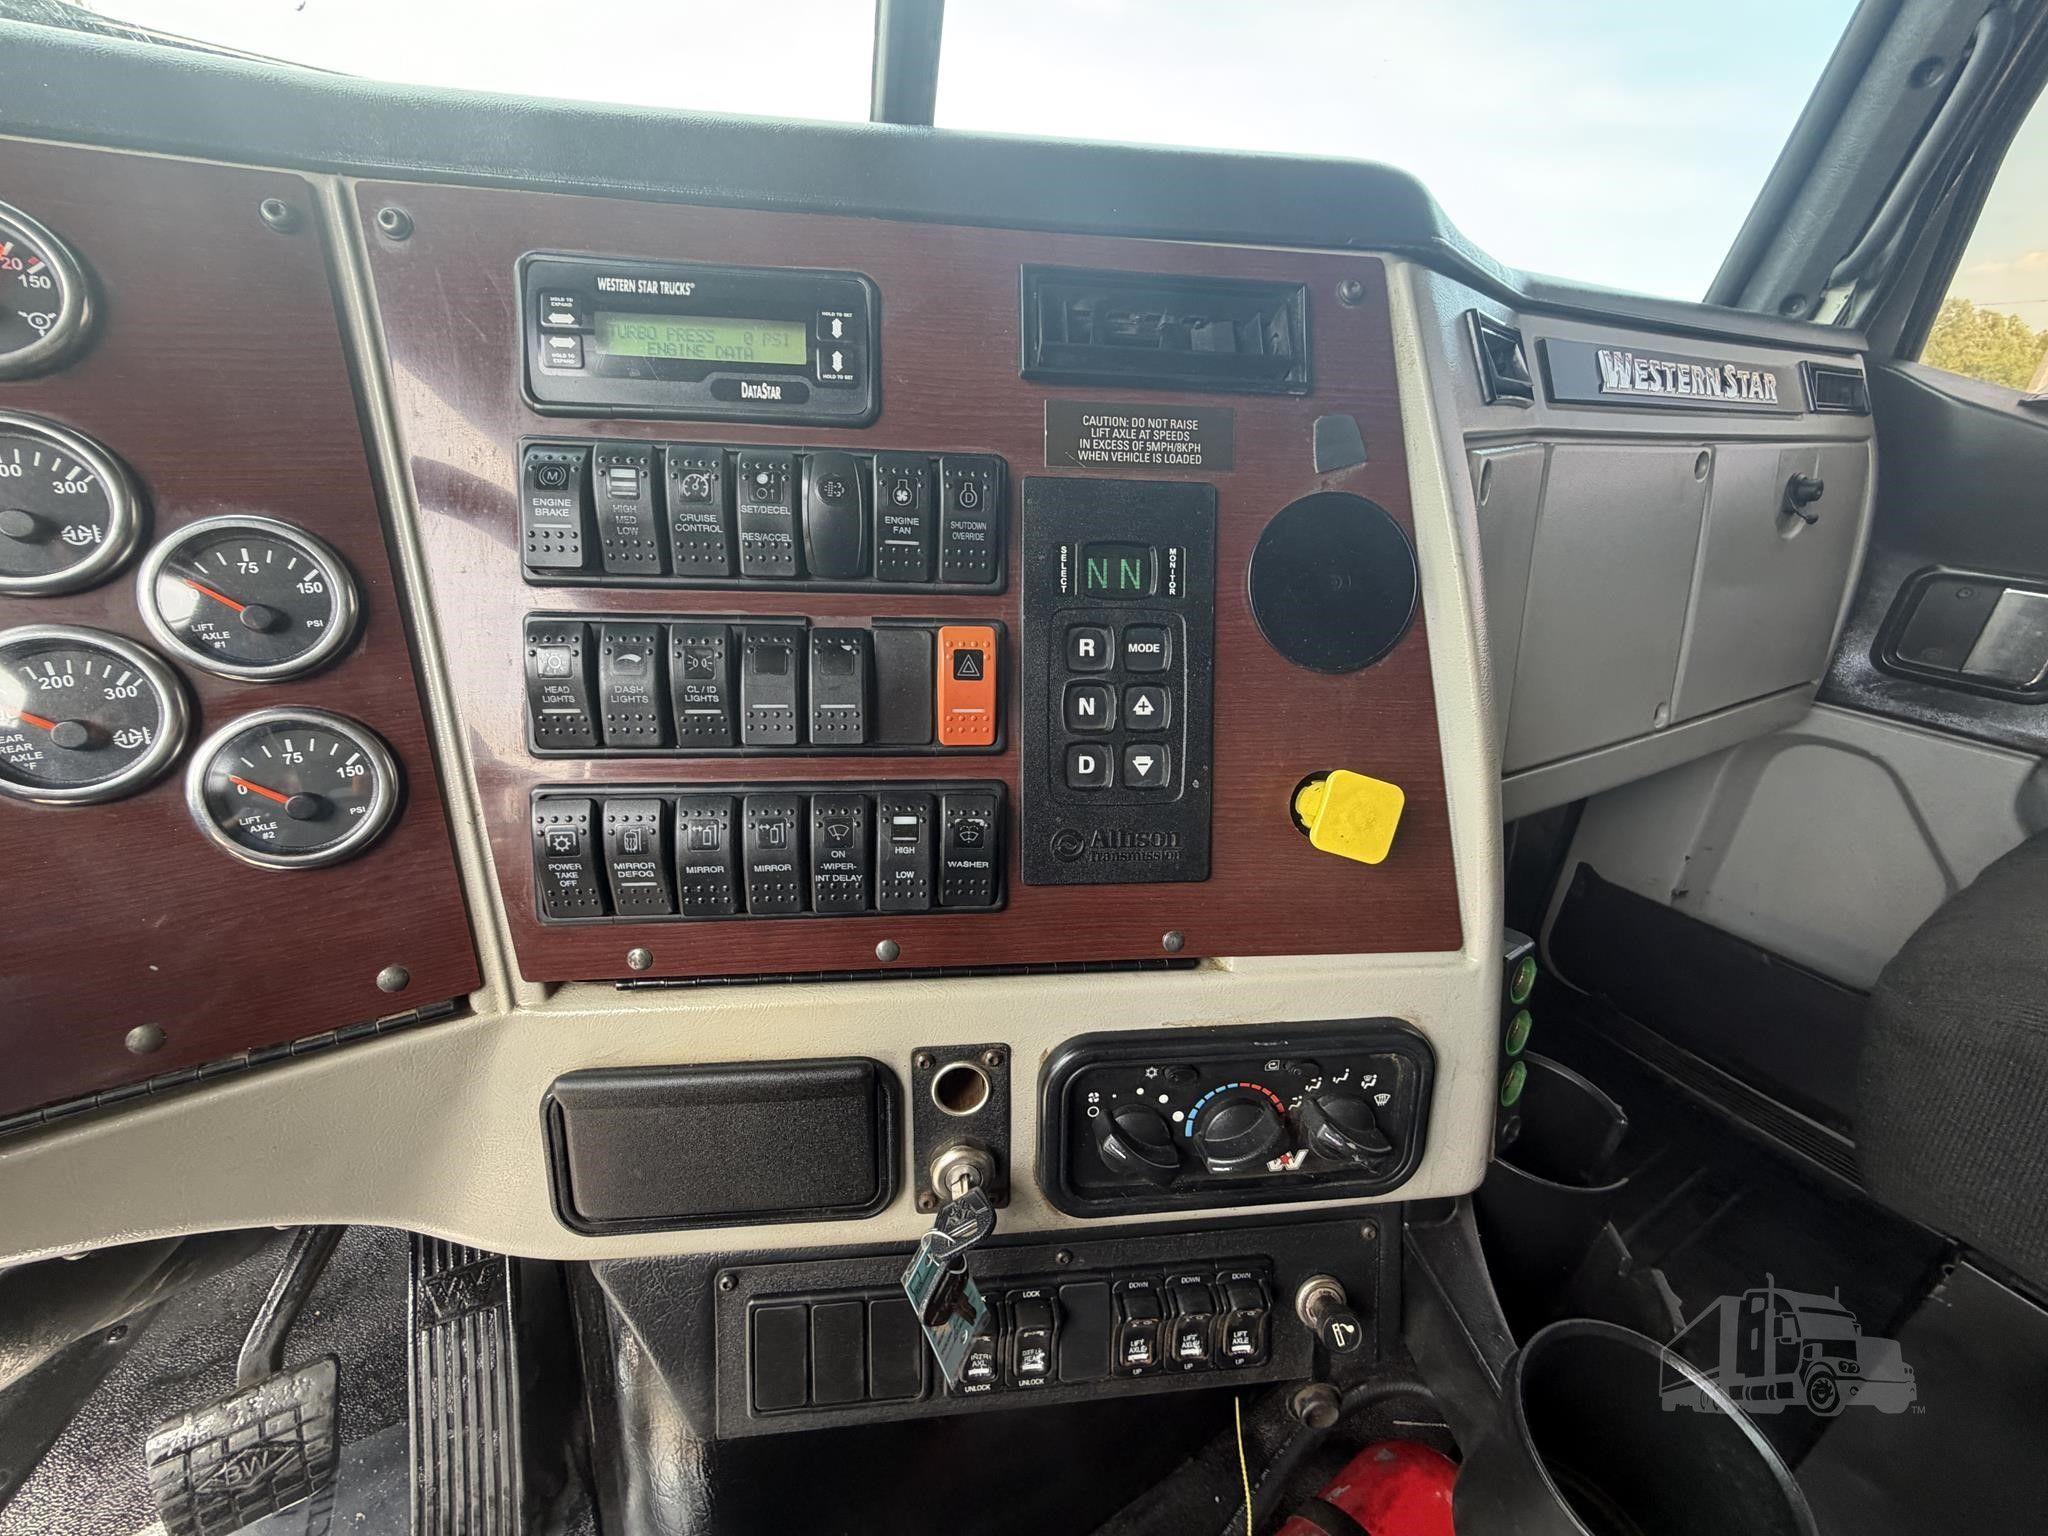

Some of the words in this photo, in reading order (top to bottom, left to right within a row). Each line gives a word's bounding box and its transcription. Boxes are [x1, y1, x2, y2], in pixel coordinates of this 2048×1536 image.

[2, 257, 23, 271] 20
[18, 274, 51, 289] 150
[597, 277, 636, 293] WESTERN
[637, 279, 659, 294] STAR
[608, 322, 657, 340] TURBO
[666, 327, 715, 344] PRESS
[762, 332, 790, 347] PSI
[647, 342, 706, 359] ENGINE
[715, 345, 754, 361] DATA
[1598, 349, 1721, 397] WESTERN
[1724, 364, 1778, 400] STAR
[1082, 415, 1130, 428] CAUTION:
[1131, 417, 1146, 428] DO
[1148, 418, 1168, 429] NOT
[1170, 419, 1199, 430] RAISE
[1091, 427, 1111, 438] LIFT
[1112, 428, 1137, 440] AXLE
[1138, 429, 1152, 440] AT
[1153, 430, 1190, 442] SPEEDS
[1079, 438, 1090, 450] IN
[1093, 439, 1130, 451] EXCESS
[1132, 440, 1144, 452] OF
[1146, 441, 1201, 453] 5MPH/8KPH
[1078, 450, 1109, 462] WHEN
[1111, 451, 1151, 463] VEHICLE
[1152, 452, 1162, 464] IS
[1164, 453, 1202, 465] LOADED
[0, 464, 22, 477] 00
[52, 481, 88, 495] 300
[532, 498, 572, 508] ENGINE
[535, 507, 570, 517] BRAKE
[612, 504, 638, 513] HIGH
[740, 505, 792, 516] SET/DECEL
[616, 515, 637, 524] MED
[679, 513, 717, 523] CRUISE
[884, 516, 920, 526] ENGINE
[675, 523, 724, 533] CONTROL
[892, 525, 912, 535] FAN
[950, 520, 987, 530] SHUTDOWN
[617, 526, 639, 536] LOW
[741, 532, 792, 542] RES/ACCEL
[952, 532, 985, 542] OVERRIDE
[237, 562, 260, 575] 75
[1060, 545, 1068, 594] SELECT
[1169, 548, 1177, 596] MONITOR
[1087, 558, 1108, 589] N
[1120, 558, 1141, 590] N
[296, 582, 324, 595] 150
[192, 623, 214, 632] LIFT
[306, 620, 324, 628] PSI
[202, 631, 232, 641] AXLE
[214, 640, 226, 649] #1
[1078, 638, 1095, 657] R
[1128, 643, 1161, 653] MODE
[38, 675, 74, 690] 200
[104, 685, 138, 700] 300
[544, 685, 570, 694] HEAD
[614, 685, 644, 694] DASH
[542, 694, 576, 703] LIGHTS
[610, 695, 650, 704] LIGHTS
[684, 694, 720, 703] LIGHTS
[1078, 697, 1095, 716] N
[0, 734, 24, 744] EAR
[0, 743, 34, 754] REAR
[10, 751, 44, 764] AXLE
[282, 752, 304, 765] 75
[1078, 756, 1096, 774] D
[336, 764, 365, 778] 150
[236, 784, 248, 795] 0
[350, 806, 366, 815] PSI
[239, 816, 262, 826] LIFT
[250, 822, 278, 833] AXLE
[262, 832, 276, 840] #2
[830, 850, 846, 859] ON
[894, 846, 916, 856] HIGH
[548, 863, 582, 871] POWER
[614, 862, 656, 870] MIRROR
[754, 864, 792, 873] MIRROR
[947, 860, 990, 869] WASHER
[618, 870, 655, 879] DEFOG
[686, 866, 725, 874] MIRROR
[896, 870, 915, 880] LOW
[555, 871, 579, 880] TAKE
[815, 874, 832, 882] INT
[833, 874, 863, 883] DELAY
[560, 880, 578, 888] OFF
[1181, 1276, 1201, 1284] DOWN
[1232, 1272, 1252, 1280] DOWN
[1128, 1282, 1149, 1290] DOWN
[1022, 1290, 1041, 1298] LOCK
[1183, 1334, 1198, 1342] LIFT
[1233, 1330, 1248, 1338] LIFT
[1130, 1338, 1145, 1347] LIFT
[1232, 1337, 1249, 1346] AXLE
[1234, 1358, 1245, 1366] UP
[1132, 1368, 1143, 1376] UP
[1018, 1378, 1045, 1387] UNLOCK
[964, 1384, 992, 1393] UNLOCK
